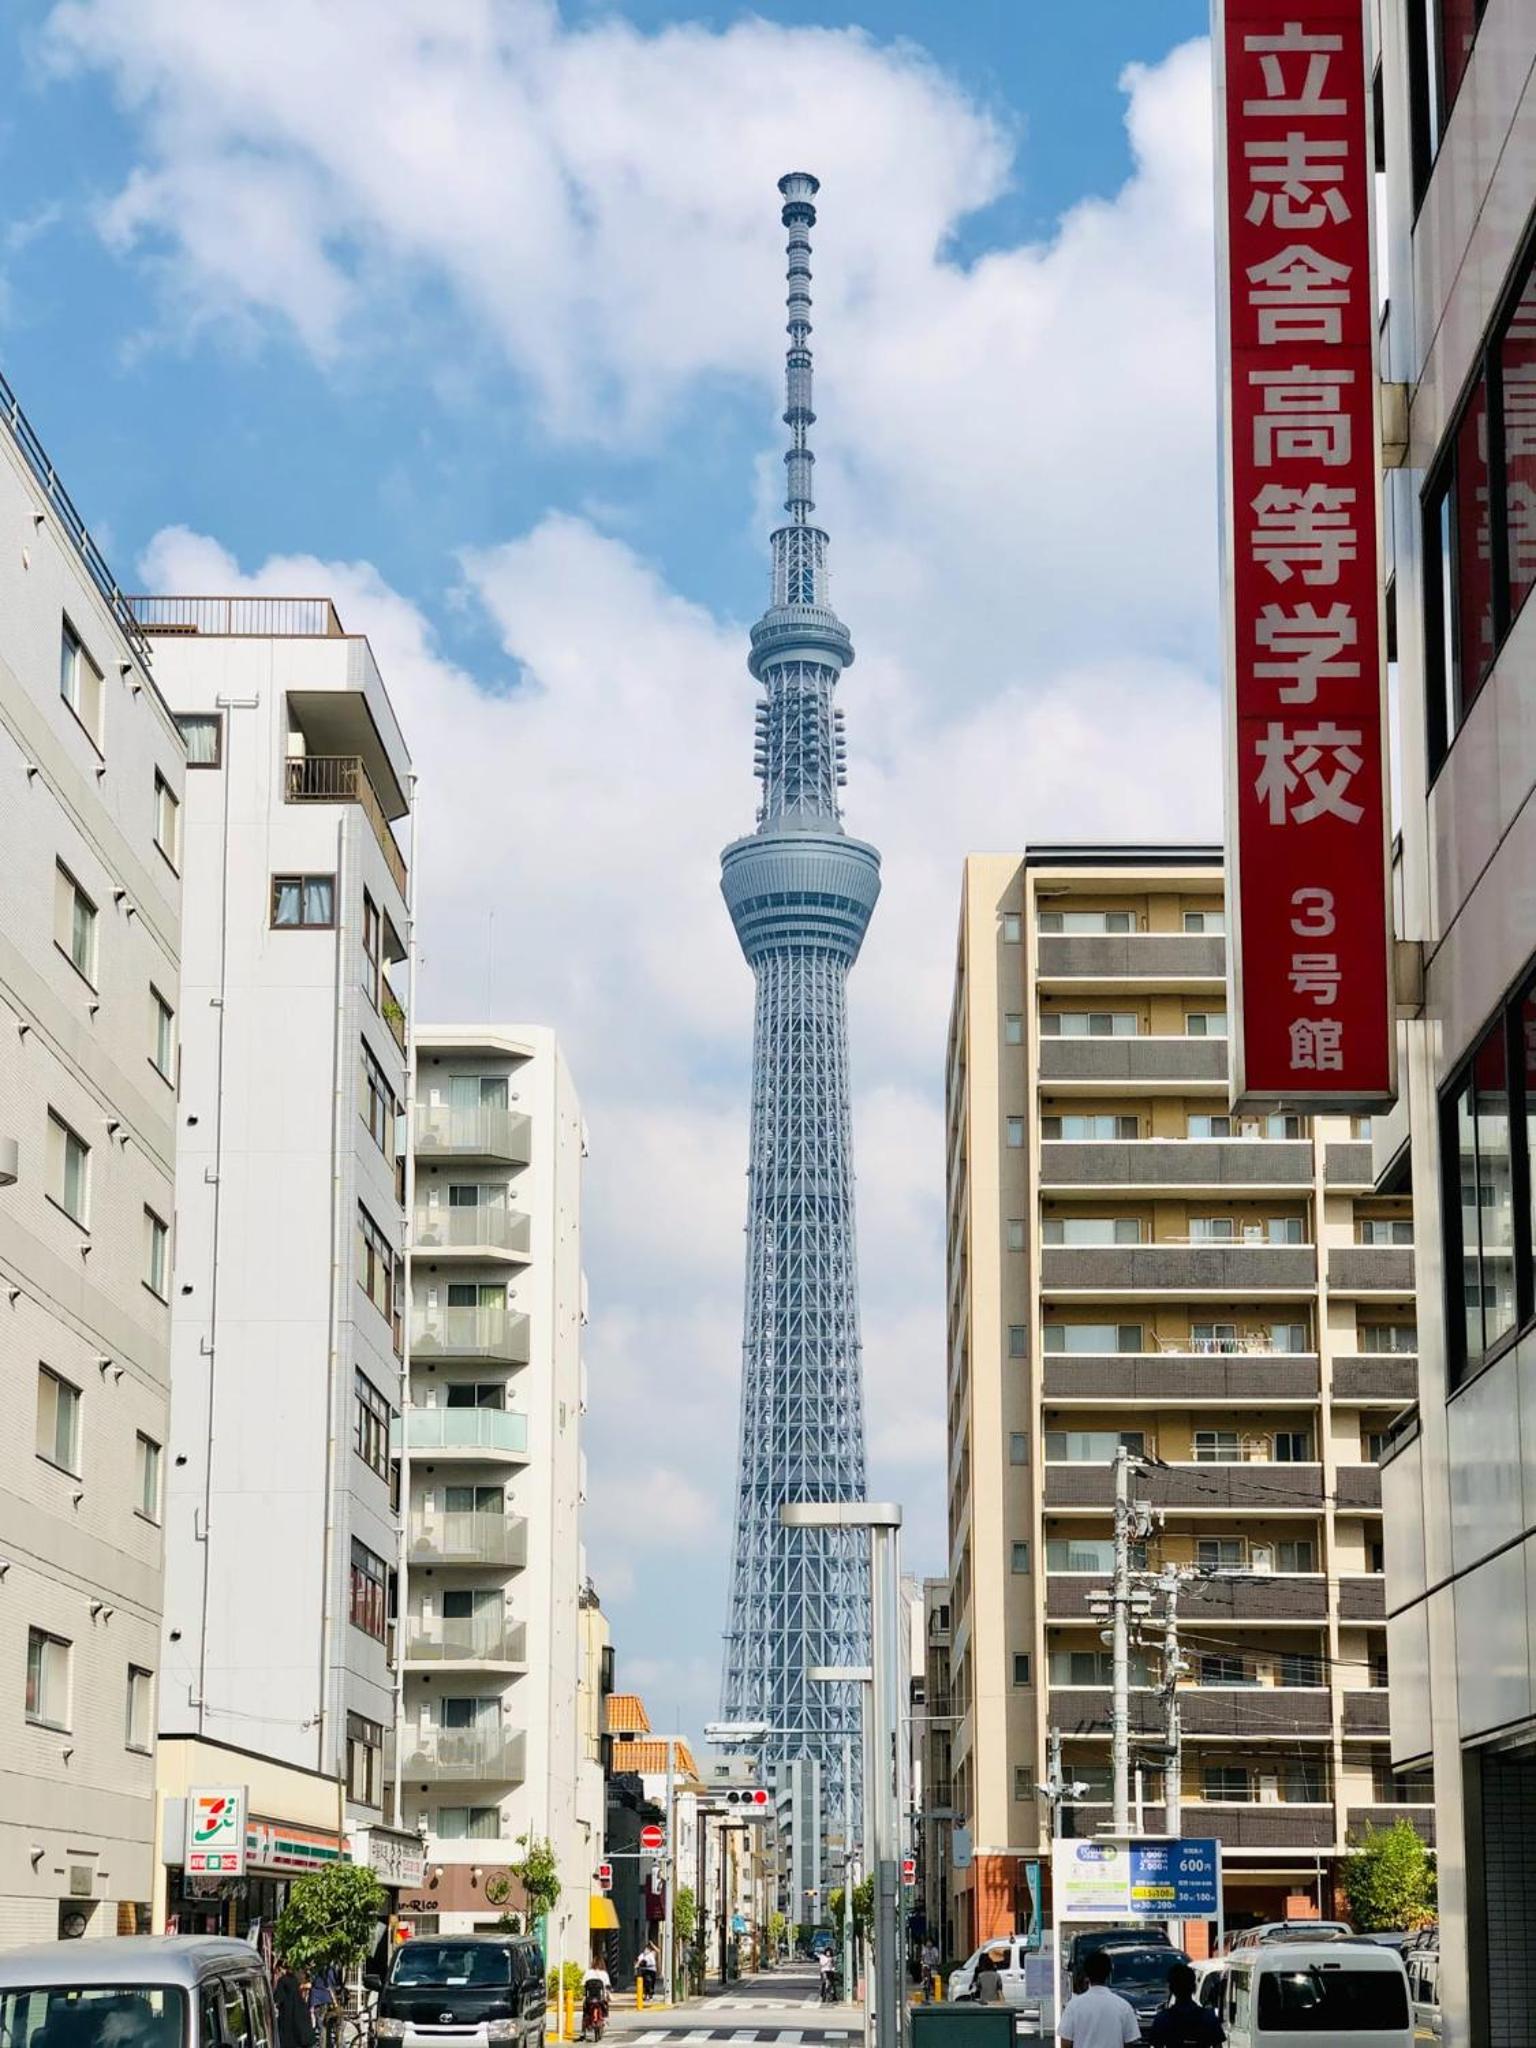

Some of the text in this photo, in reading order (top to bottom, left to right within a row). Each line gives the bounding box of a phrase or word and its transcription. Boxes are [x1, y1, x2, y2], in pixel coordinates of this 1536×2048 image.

[1244, 23, 1363, 1071] 立志舎高等学校 3号館
